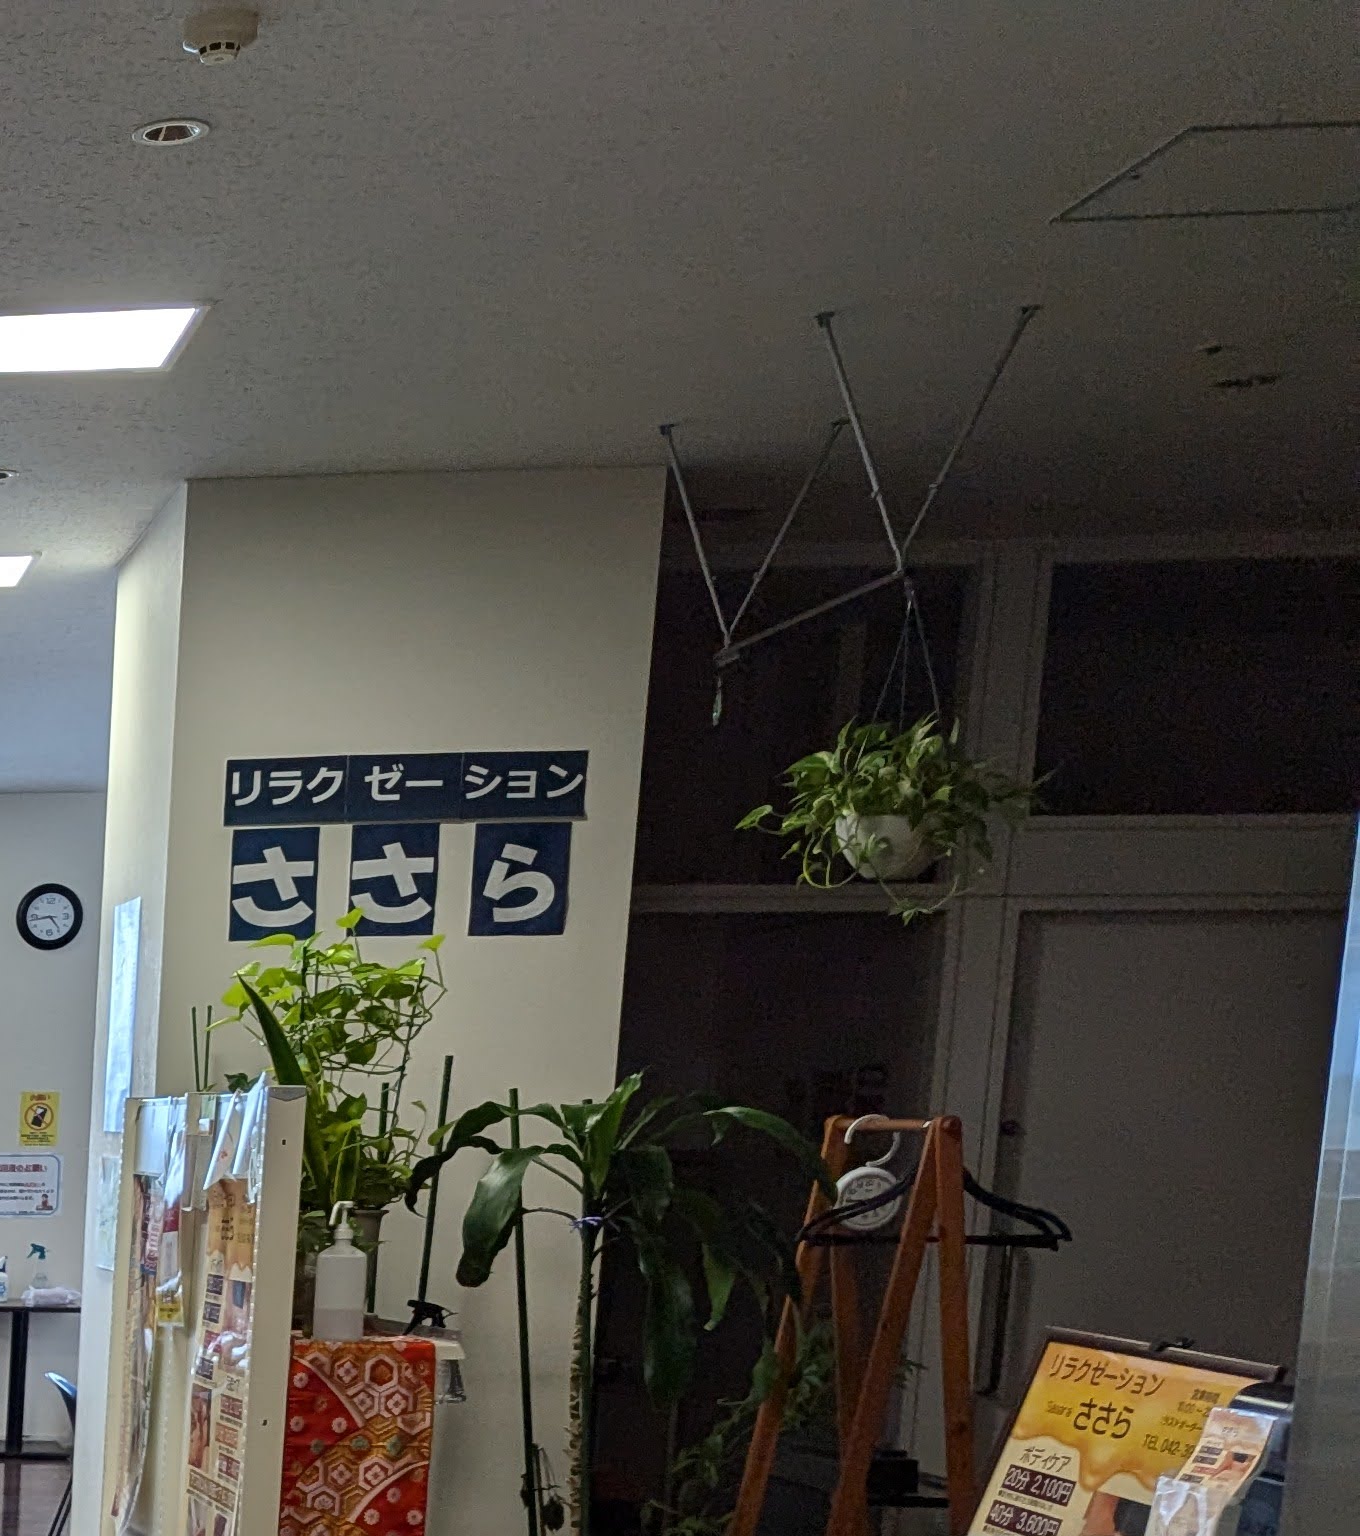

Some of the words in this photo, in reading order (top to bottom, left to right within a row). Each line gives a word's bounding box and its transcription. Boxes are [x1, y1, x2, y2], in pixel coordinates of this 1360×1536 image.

[231, 763, 584, 806] リラクゼーション
[231, 842, 556, 928] ささら
[1049, 1353, 1166, 1397] リラクゼーション
[1073, 1397, 1134, 1439] ささら
[1003, 1467, 1030, 1490] 20分
[1020, 1446, 1072, 1473] ボディケア
[989, 1503, 1015, 1524] 40分
